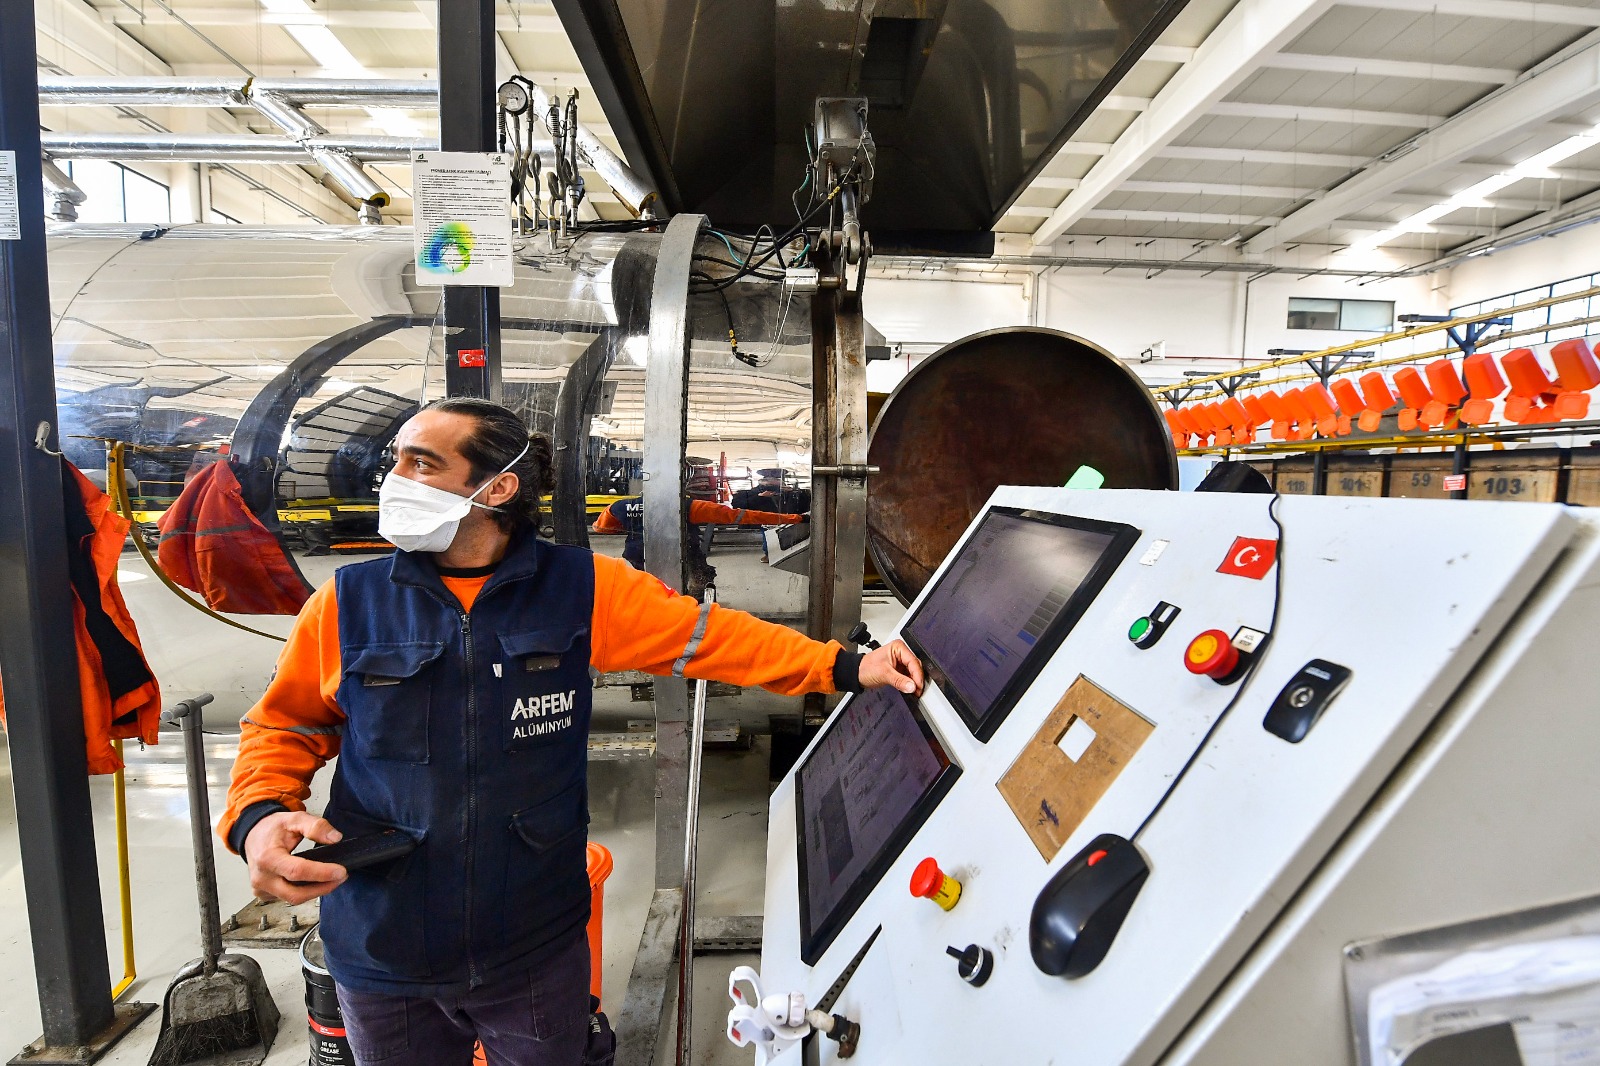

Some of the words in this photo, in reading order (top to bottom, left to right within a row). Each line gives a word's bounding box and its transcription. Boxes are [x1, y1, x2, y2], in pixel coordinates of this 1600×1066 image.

[1411, 473, 1431, 487] 59
[1484, 477, 1520, 494] 103
[510, 690, 576, 720] ARFEM
[512, 715, 572, 739] ALÜMİNYUM
